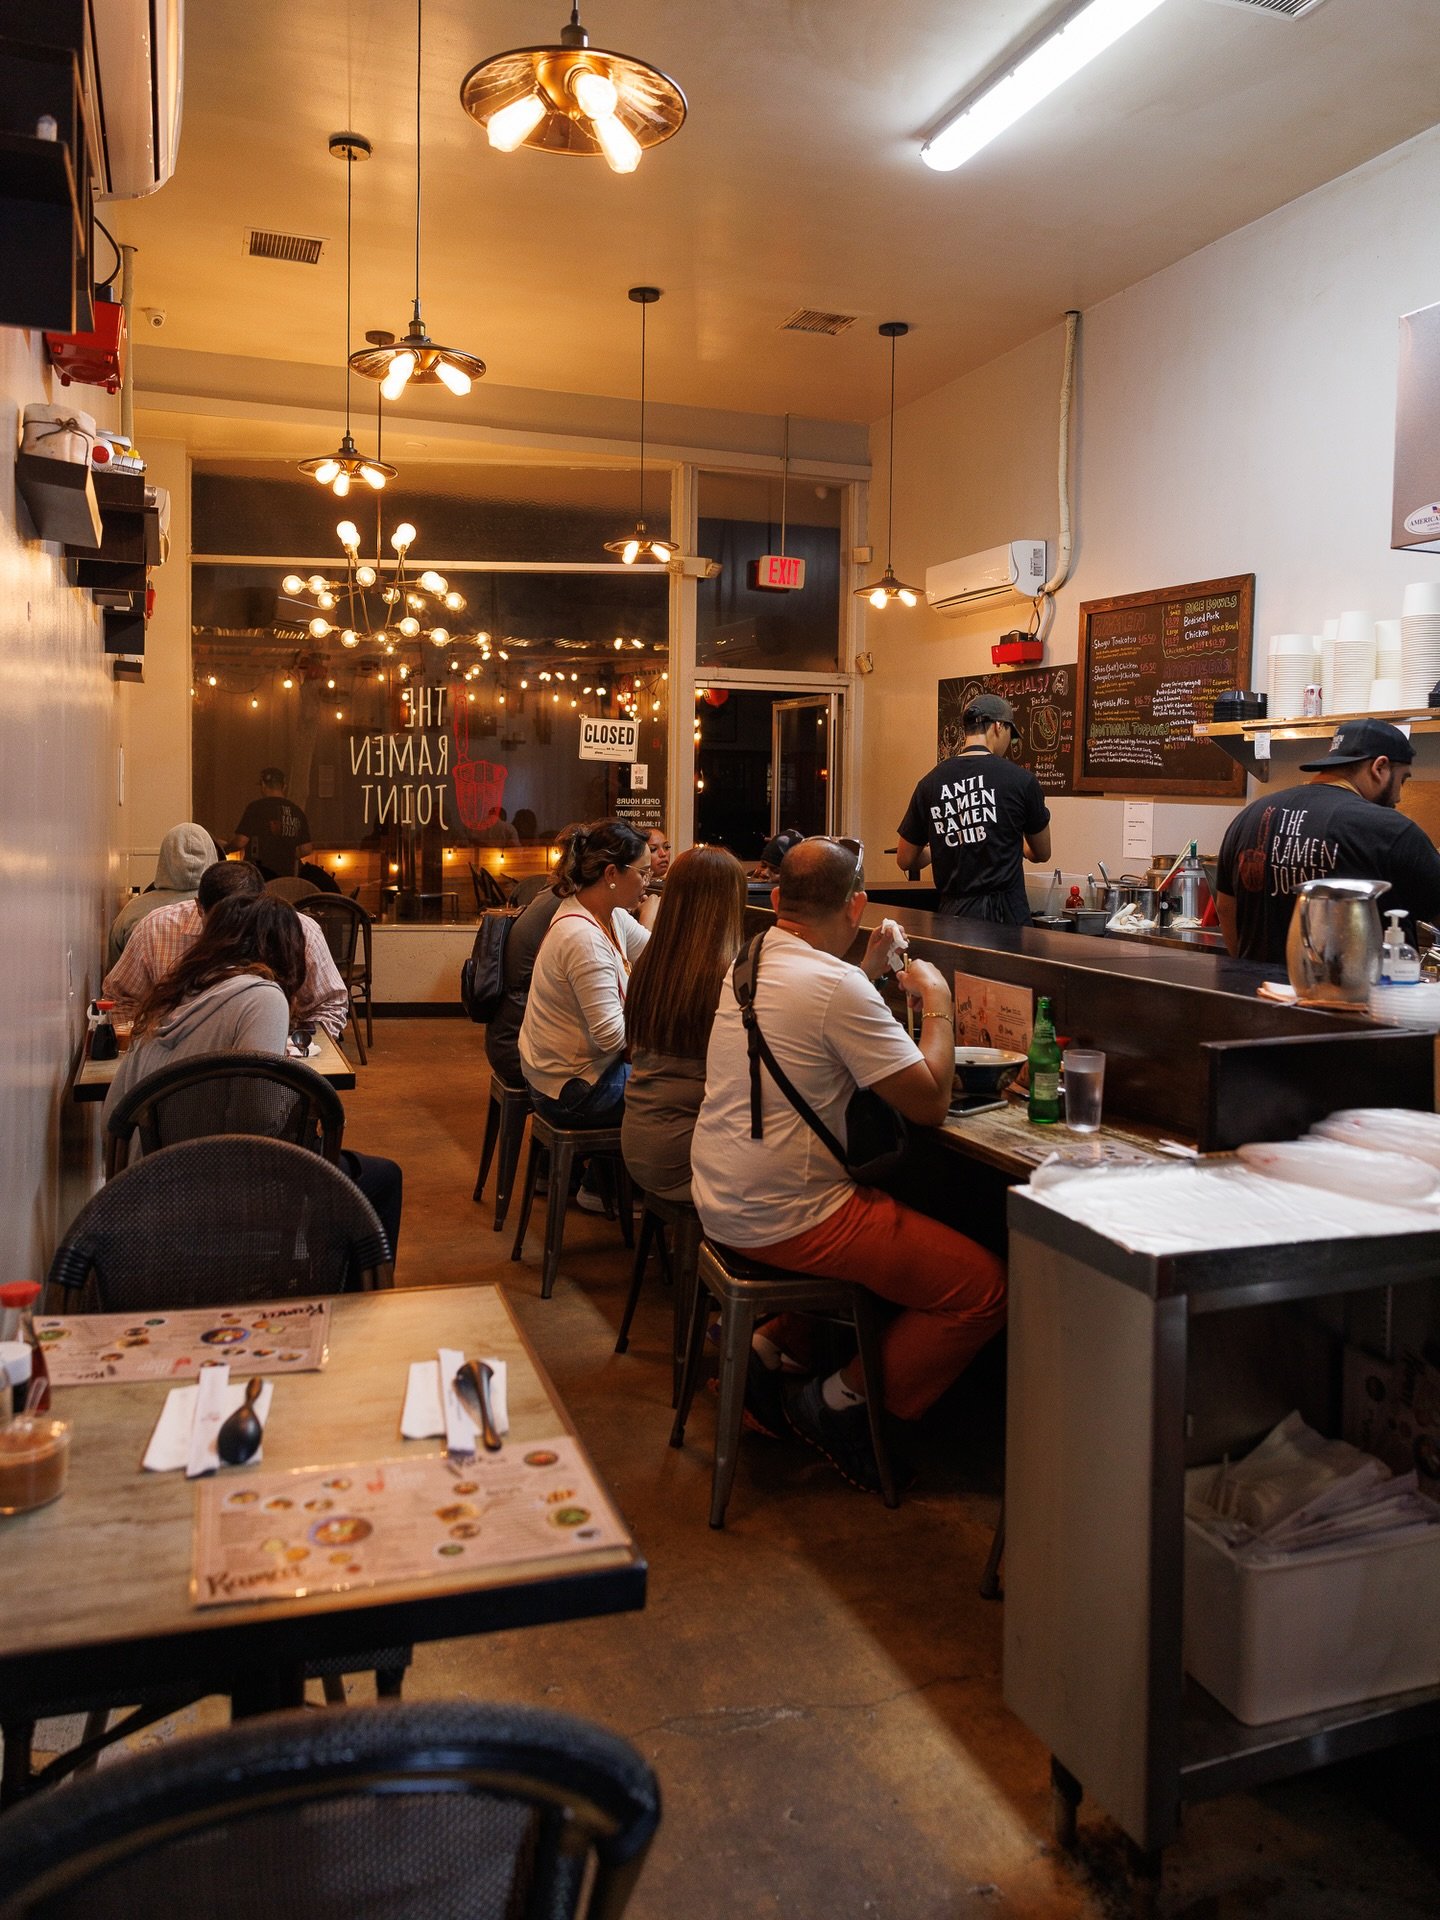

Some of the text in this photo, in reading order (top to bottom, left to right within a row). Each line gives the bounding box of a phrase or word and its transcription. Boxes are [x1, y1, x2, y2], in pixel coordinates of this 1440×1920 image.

[1410, 514, 1440, 526] AMERICA
[769, 557, 800, 586] EXIT
[1184, 611, 1220, 627] Braised Pork
[1185, 621, 1239, 640] Chicken Rice Bowl
[1111, 635, 1137, 646] Tonkotsu
[584, 724, 635, 745] CLOSED
[941, 775, 984, 800] ANTI
[930, 788, 996, 819] RAMEN
[934, 806, 997, 834] RAMEN
[1279, 808, 1308, 836] THE
[945, 825, 987, 847] CLUB
[1271, 836, 1339, 869] RAMEN
